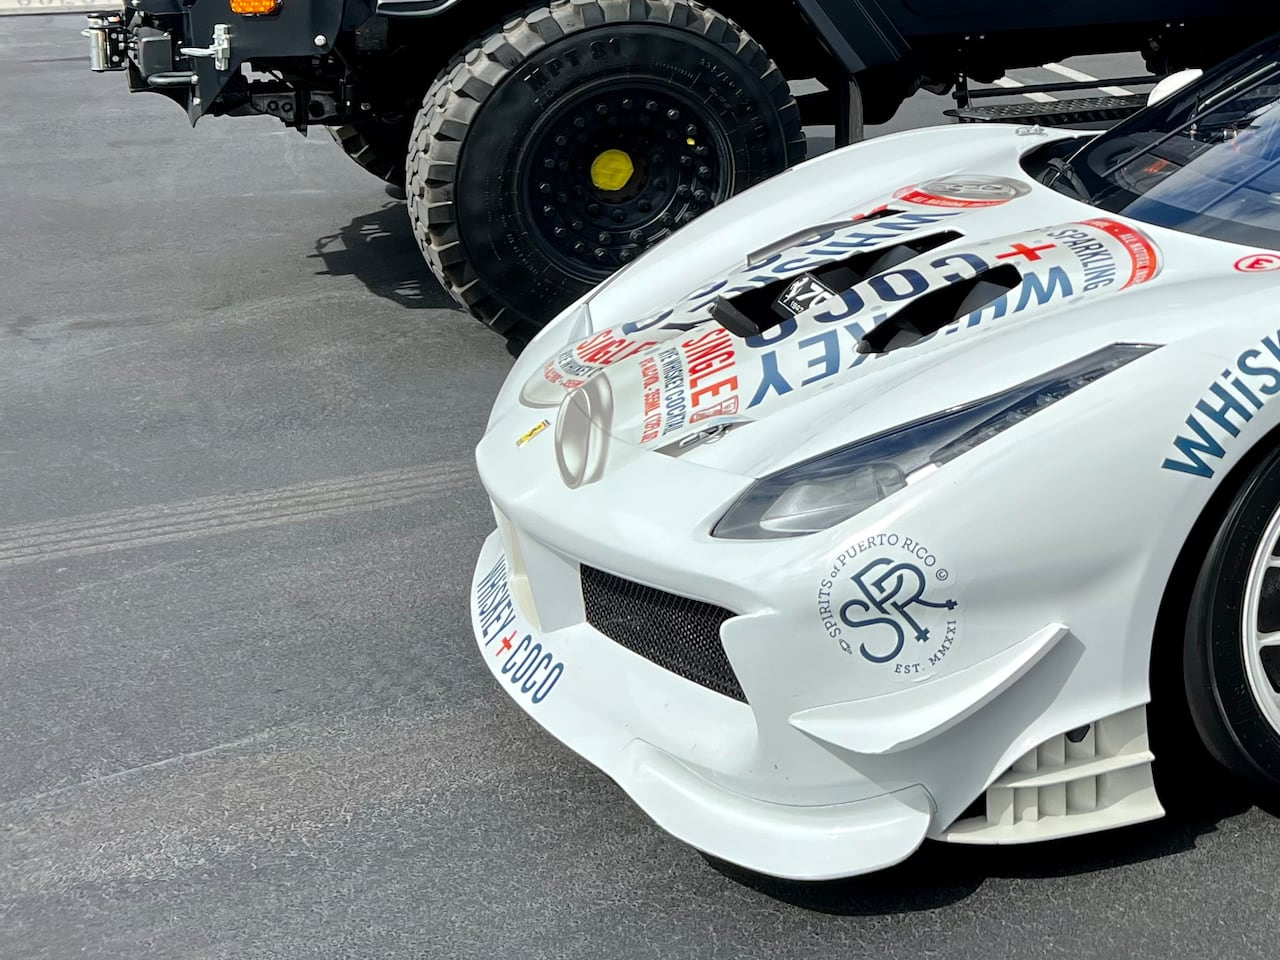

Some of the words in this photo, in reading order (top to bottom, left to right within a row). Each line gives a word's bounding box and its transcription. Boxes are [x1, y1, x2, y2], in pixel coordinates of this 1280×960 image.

[1047, 228, 1116, 292] SPARKLING
[682, 327, 739, 409] SINGLE
[818, 579, 842, 638] SPIRITS
[836, 533, 900, 567] PUERTO
[901, 537, 936, 567] RICO
[928, 620, 957, 666] MMXXI
